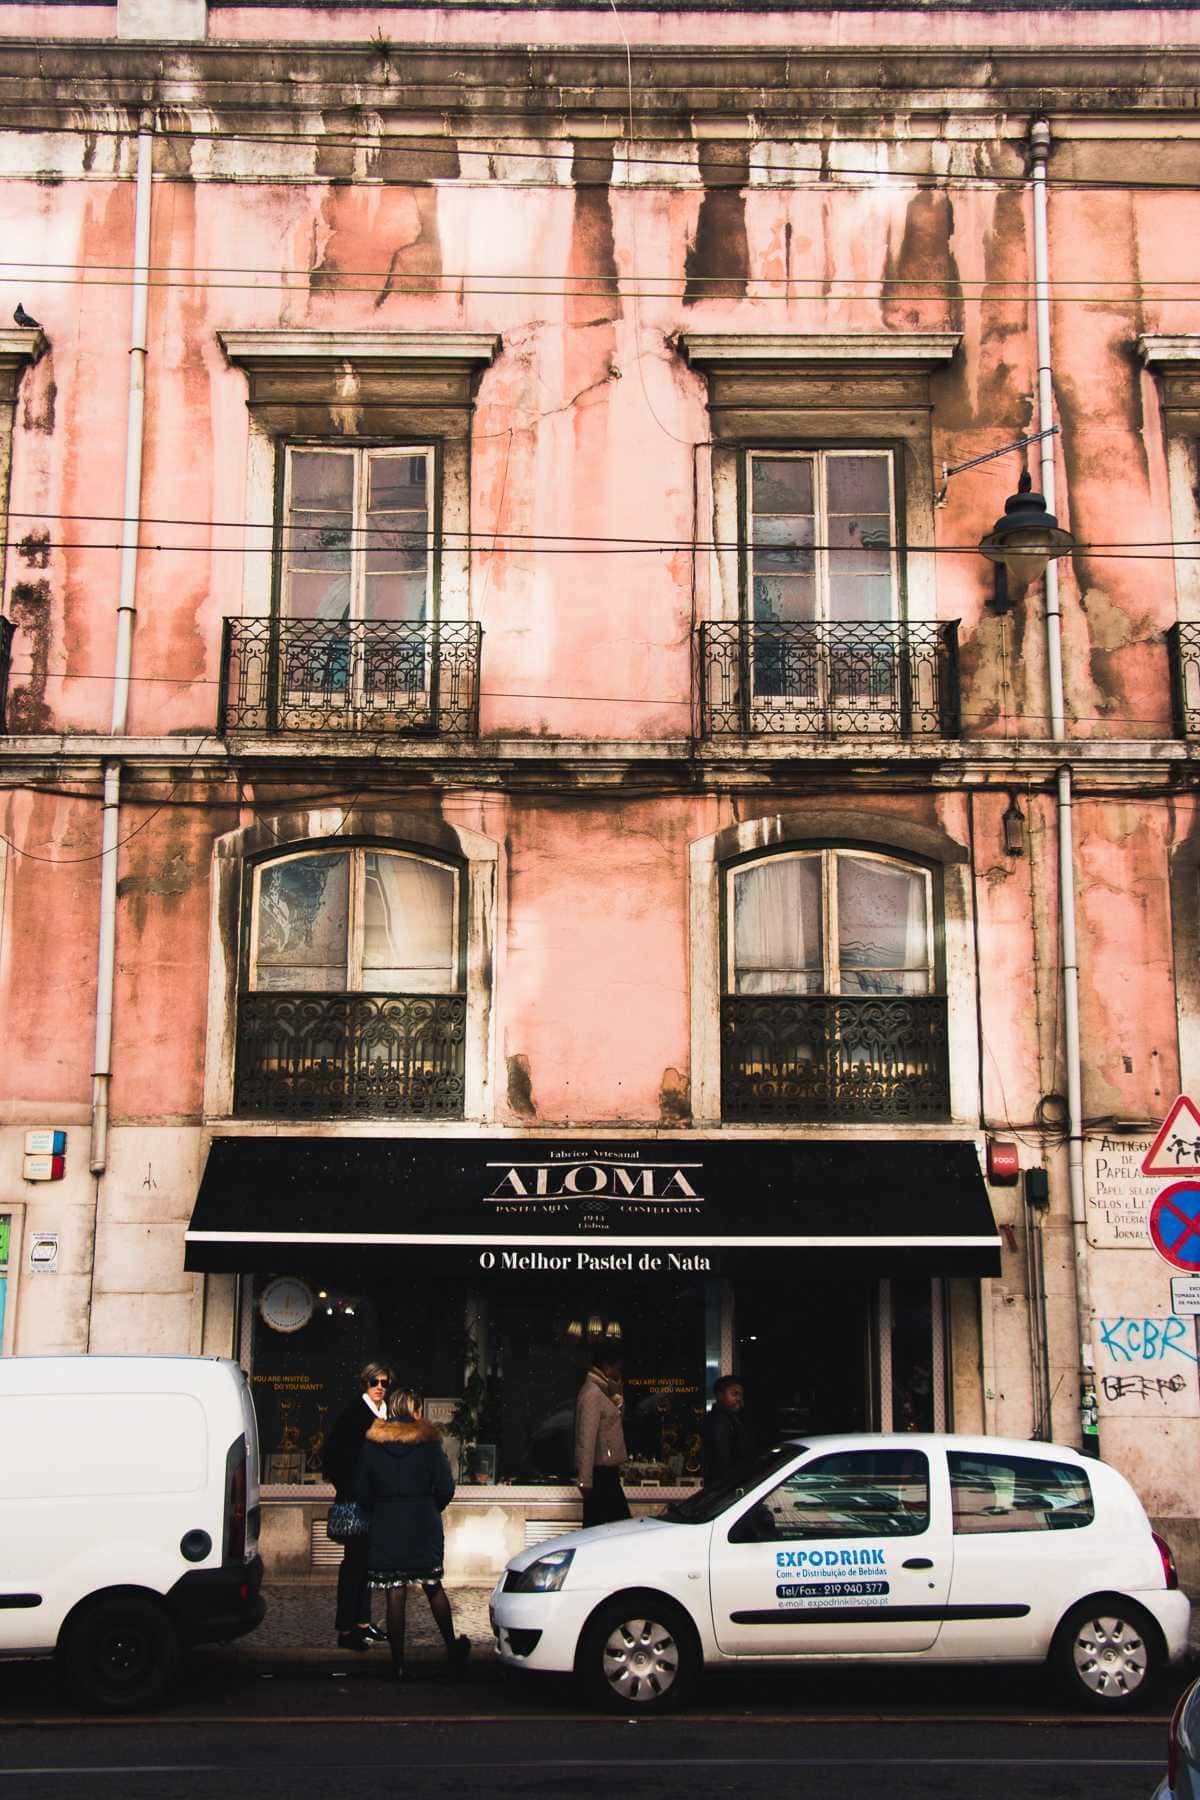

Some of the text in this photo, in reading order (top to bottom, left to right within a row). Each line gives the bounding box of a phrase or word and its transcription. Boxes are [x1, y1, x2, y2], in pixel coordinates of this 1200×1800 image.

[550, 1149, 640, 1159] Fabrico Artesanal
[1121, 1155, 1136, 1164] DE
[1096, 1158, 1141, 1179] PAPELA
[490, 1165, 698, 1197] ALOMA
[1089, 1196, 1122, 1209] SELOS
[1105, 1209, 1149, 1224] LOTERIA
[479, 1252, 711, 1271] O Melhor Pastel de Nata
[1100, 1316, 1198, 1362] KCBR
[253, 1375, 310, 1383] YOU ARE INVITED
[776, 1548, 886, 1568] EXPODRINK
[776, 1569, 795, 1579] Com.
[802, 1567, 847, 1579] Distribuição
[848, 1568, 857, 1577] de
[859, 1567, 888, 1576] Bebidas
[824, 1584, 841, 1595] 219
[844, 1583, 863, 1594] 940
[865, 1583, 883, 1593] 377
